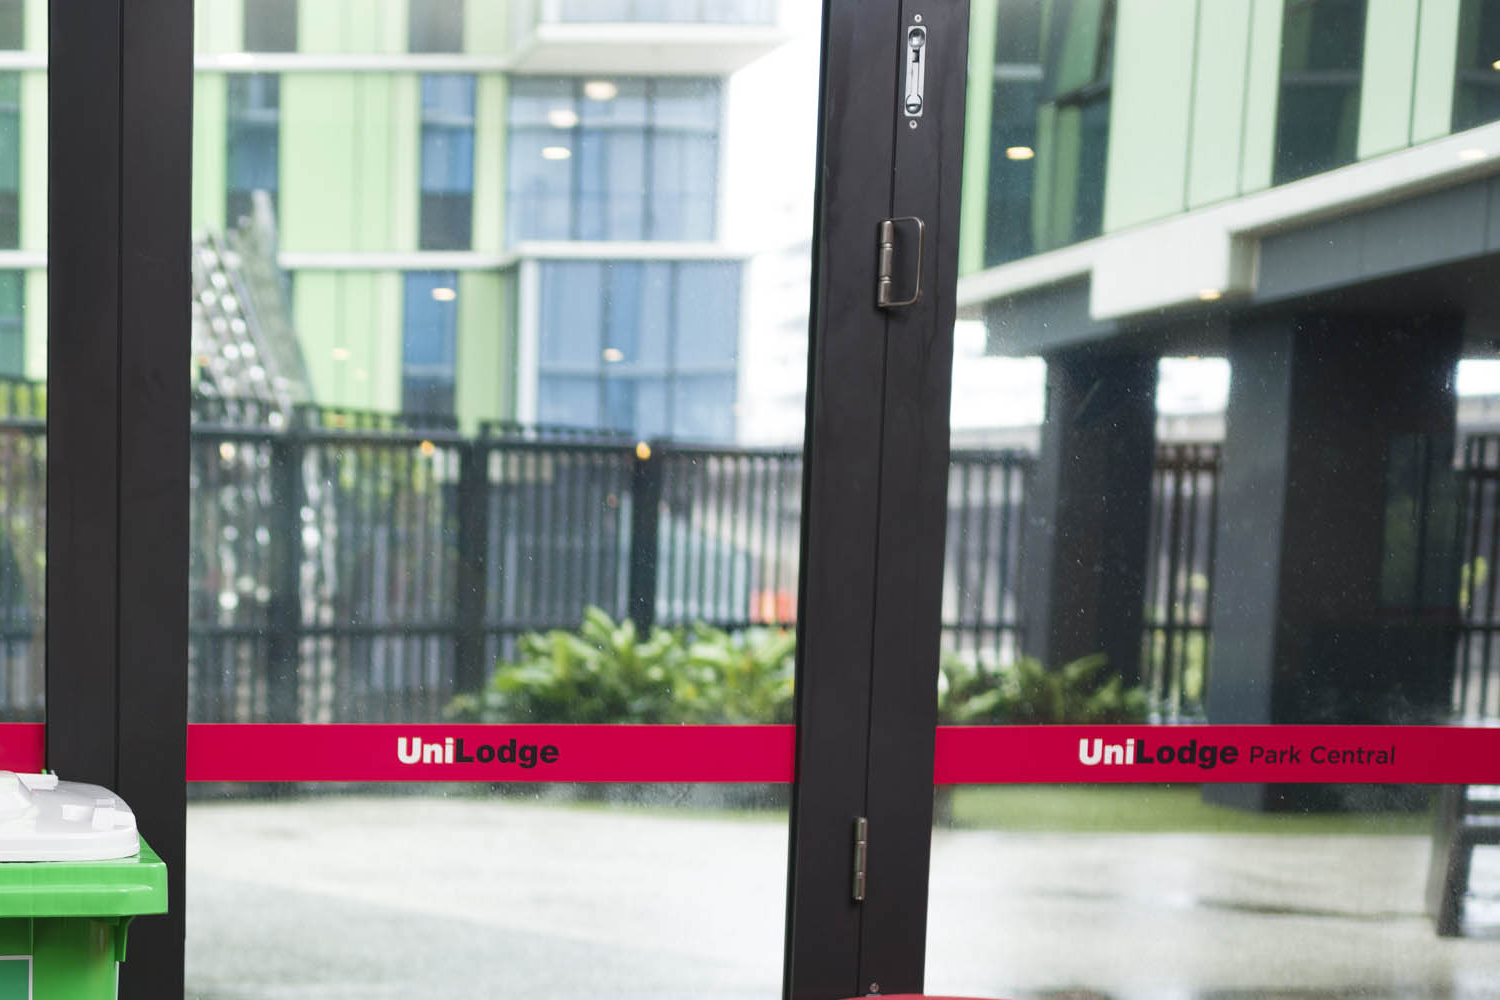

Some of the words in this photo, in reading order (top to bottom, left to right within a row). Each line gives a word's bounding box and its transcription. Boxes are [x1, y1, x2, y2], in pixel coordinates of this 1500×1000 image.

[397, 736, 560, 769] UniLodge
[1078, 737, 1239, 770] UniLodge
[1249, 745, 1301, 765] Park
[1310, 744, 1397, 766] Central
